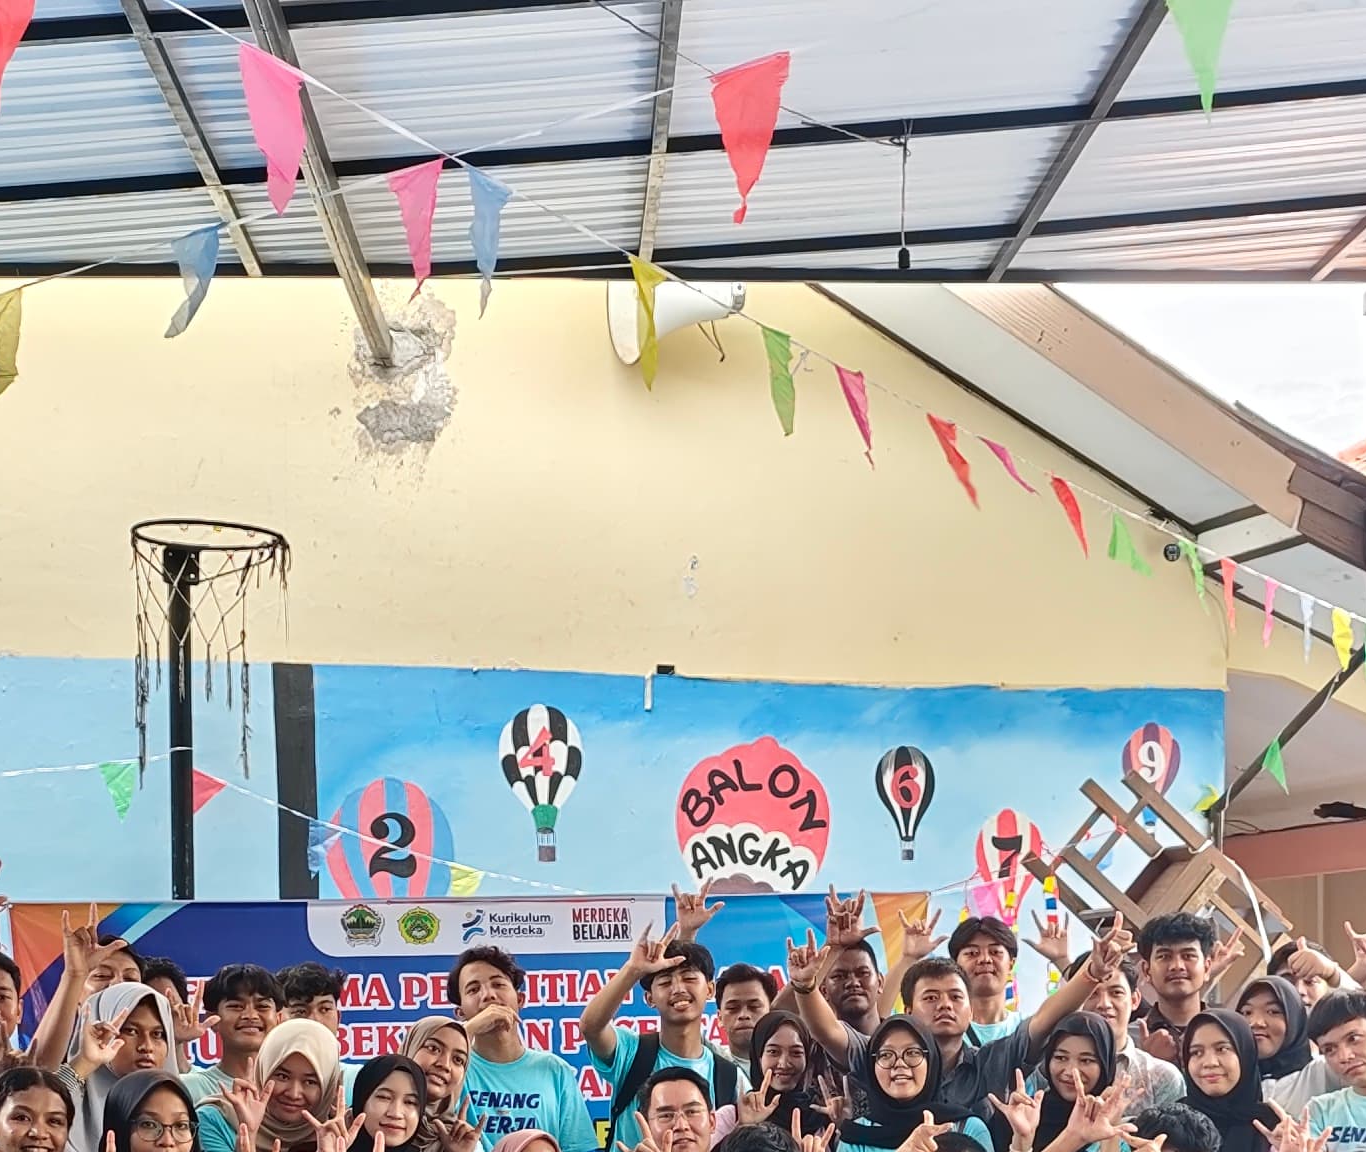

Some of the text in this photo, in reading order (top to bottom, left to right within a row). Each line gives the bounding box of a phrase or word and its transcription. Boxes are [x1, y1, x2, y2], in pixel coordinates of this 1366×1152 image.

[519, 726, 555, 777] 4
[1138, 740, 1166, 784] 9
[681, 759, 827, 831] BALON
[891, 764, 921, 809] 6
[369, 812, 417, 878] 2
[691, 832, 810, 891] ANGKA
[991, 834, 1023, 878] 7
[489, 912, 552, 924] Kurikulum
[489, 925, 543, 936] Merdeka
[572, 907, 628, 923] MERDEKA
[572, 923, 630, 941] BELAJAR
[469, 1090, 541, 1109] SENANG
[477, 1116, 537, 1134] ERJA
